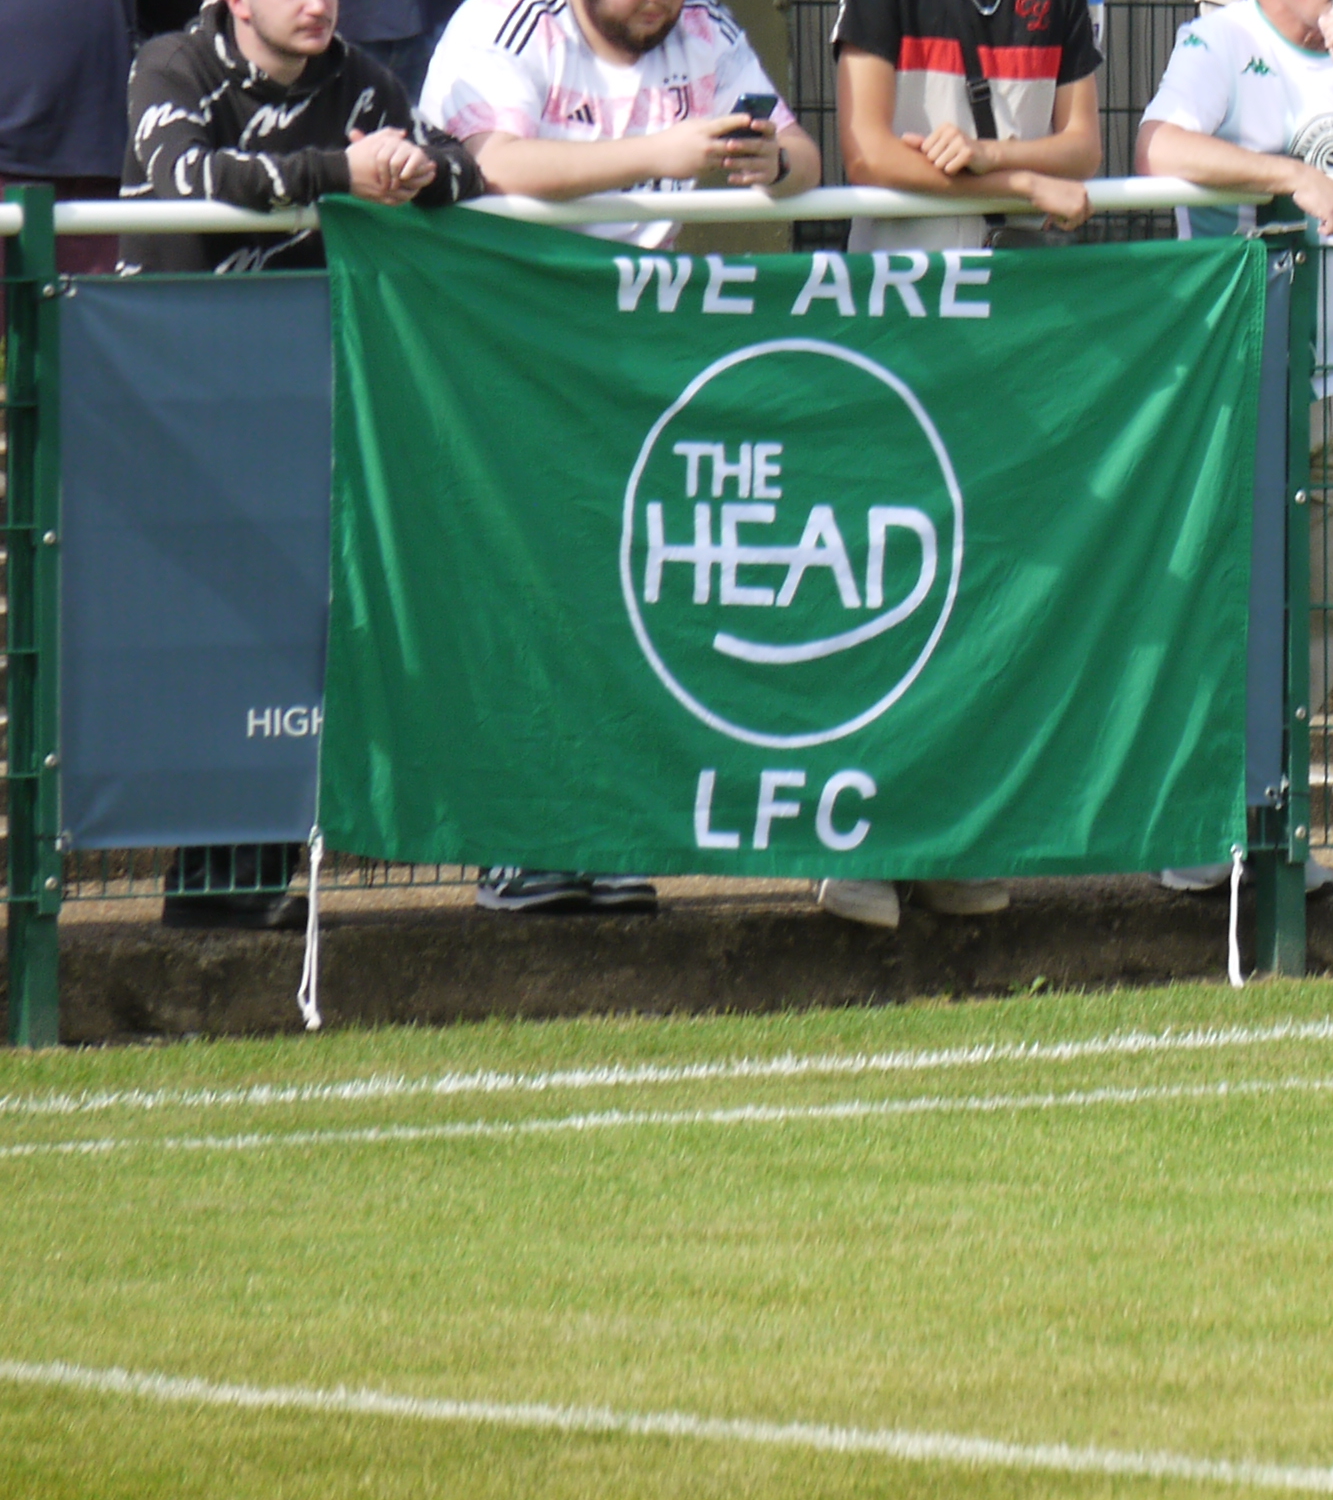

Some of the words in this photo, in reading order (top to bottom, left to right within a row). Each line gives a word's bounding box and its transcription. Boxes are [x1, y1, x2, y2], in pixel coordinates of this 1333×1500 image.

[613, 256, 755, 313] WE
[791, 248, 993, 318] ARE
[674, 442, 783, 500] THE
[644, 502, 938, 663] HEAD
[693, 770, 877, 851] LFC
